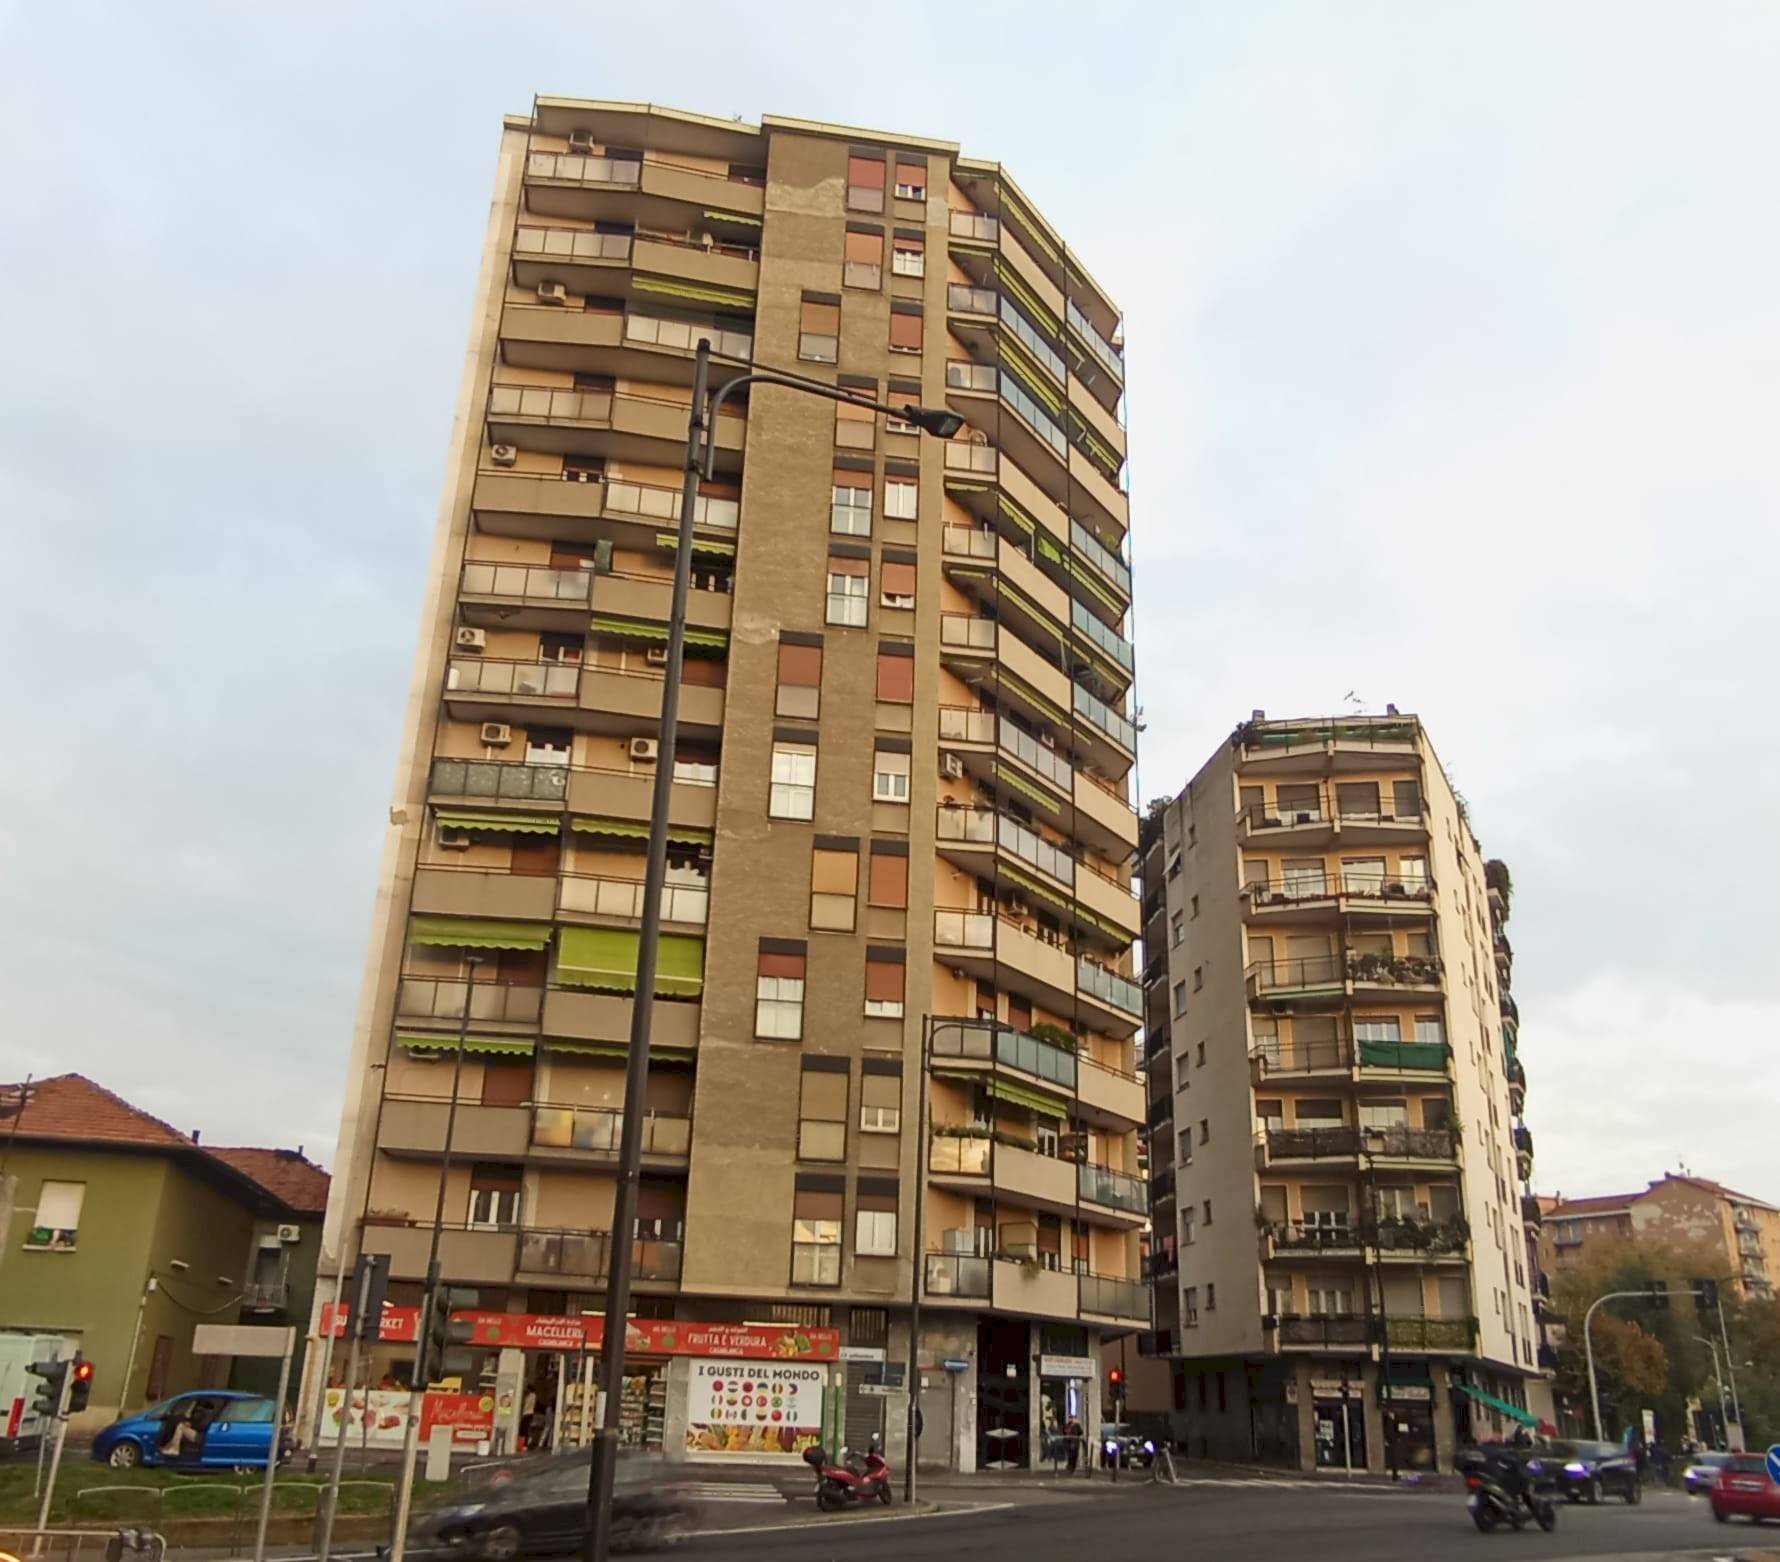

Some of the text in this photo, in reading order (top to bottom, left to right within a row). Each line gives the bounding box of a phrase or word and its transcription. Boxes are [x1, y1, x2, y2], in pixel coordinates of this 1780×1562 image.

[687, 1332, 719, 1345] FRUTTA
[729, 1335, 767, 1347] VERDURA
[698, 1365, 820, 1381] I GUSTI DEL MONDO
